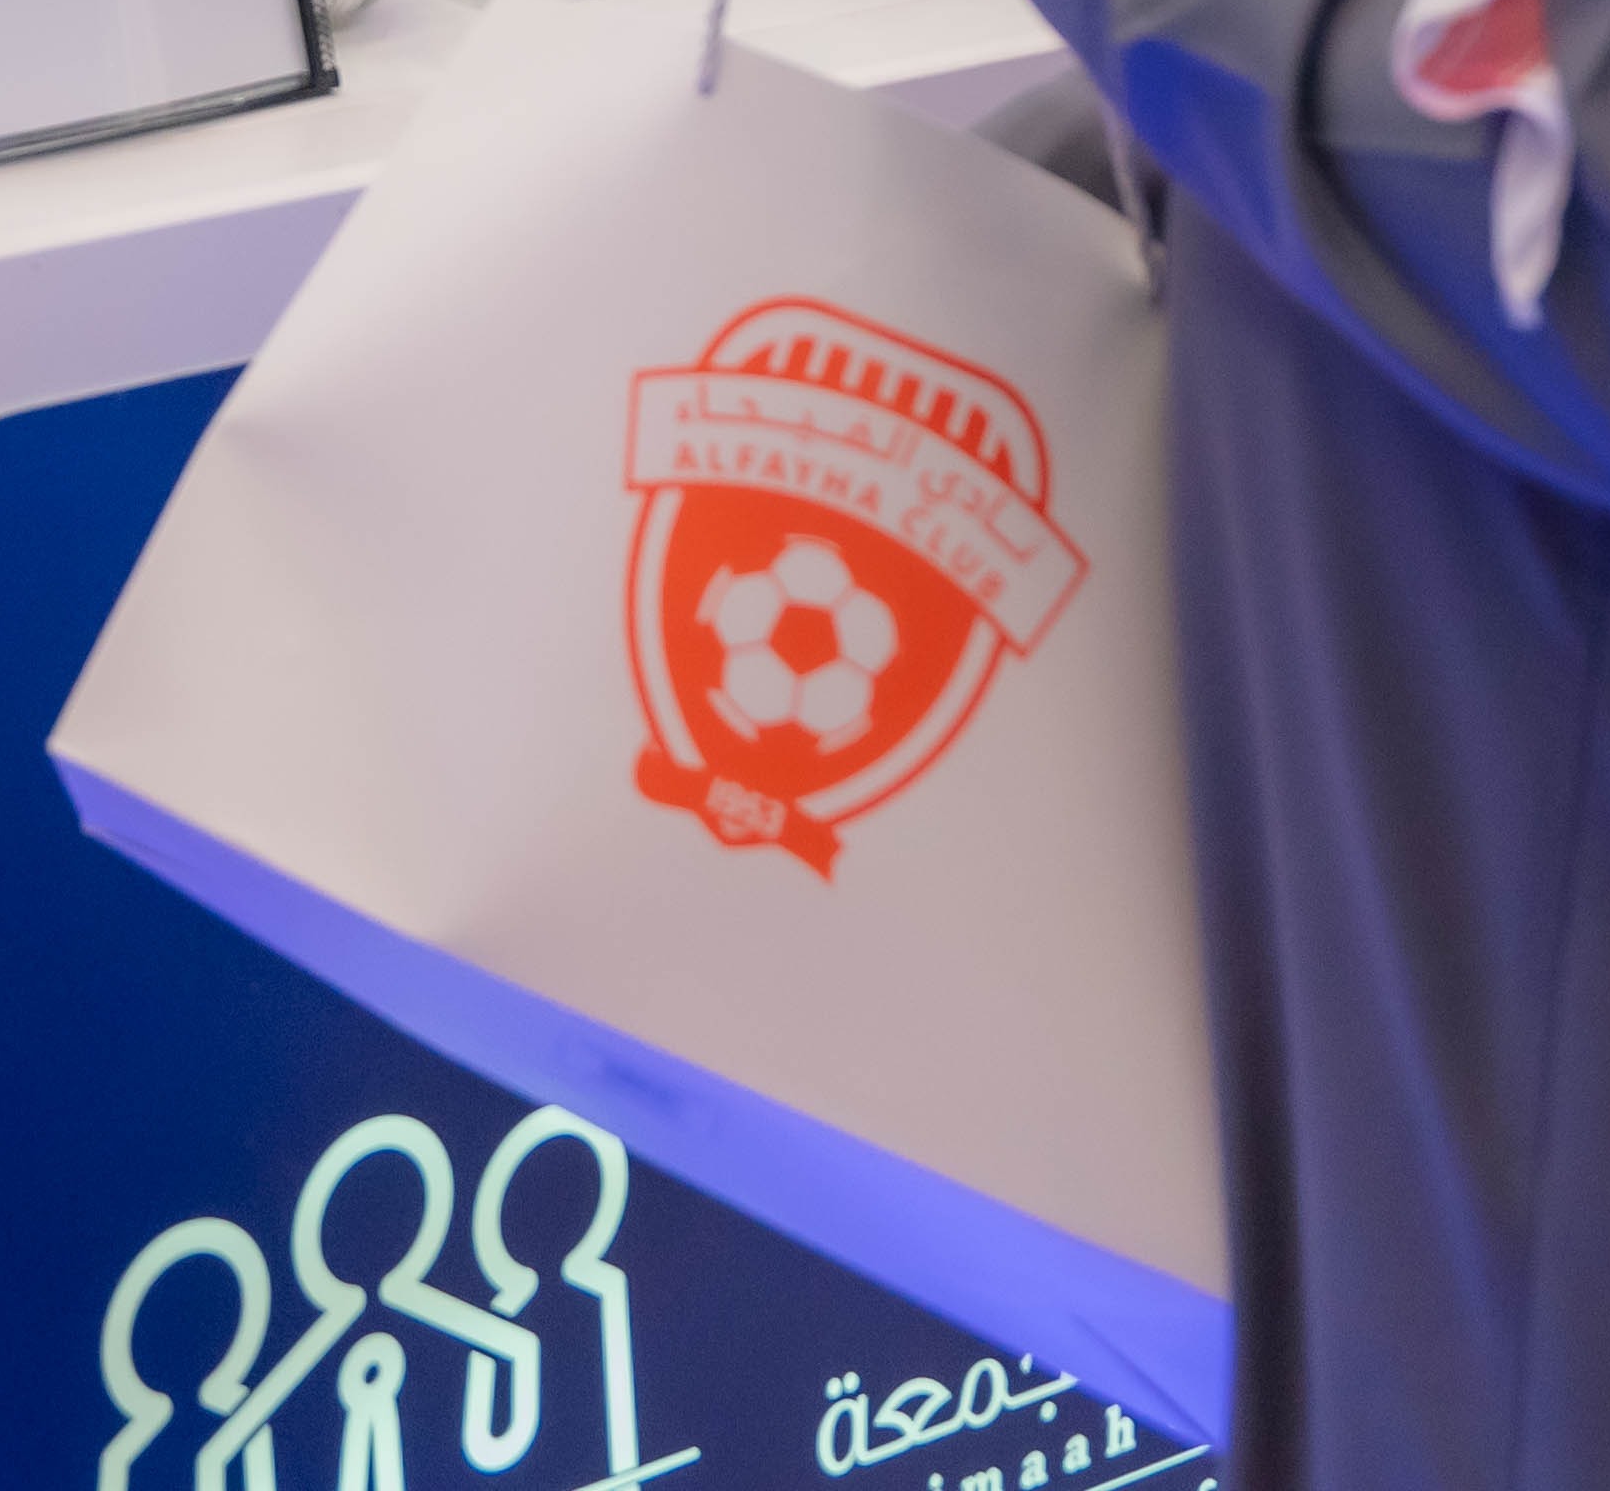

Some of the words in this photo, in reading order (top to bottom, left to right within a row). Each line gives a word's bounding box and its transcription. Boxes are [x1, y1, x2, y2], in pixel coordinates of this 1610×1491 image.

[673, 441, 883, 516] ALFAYHA
[899, 505, 1006, 601] CLUB
[928, 1403, 1138, 1491] maah
